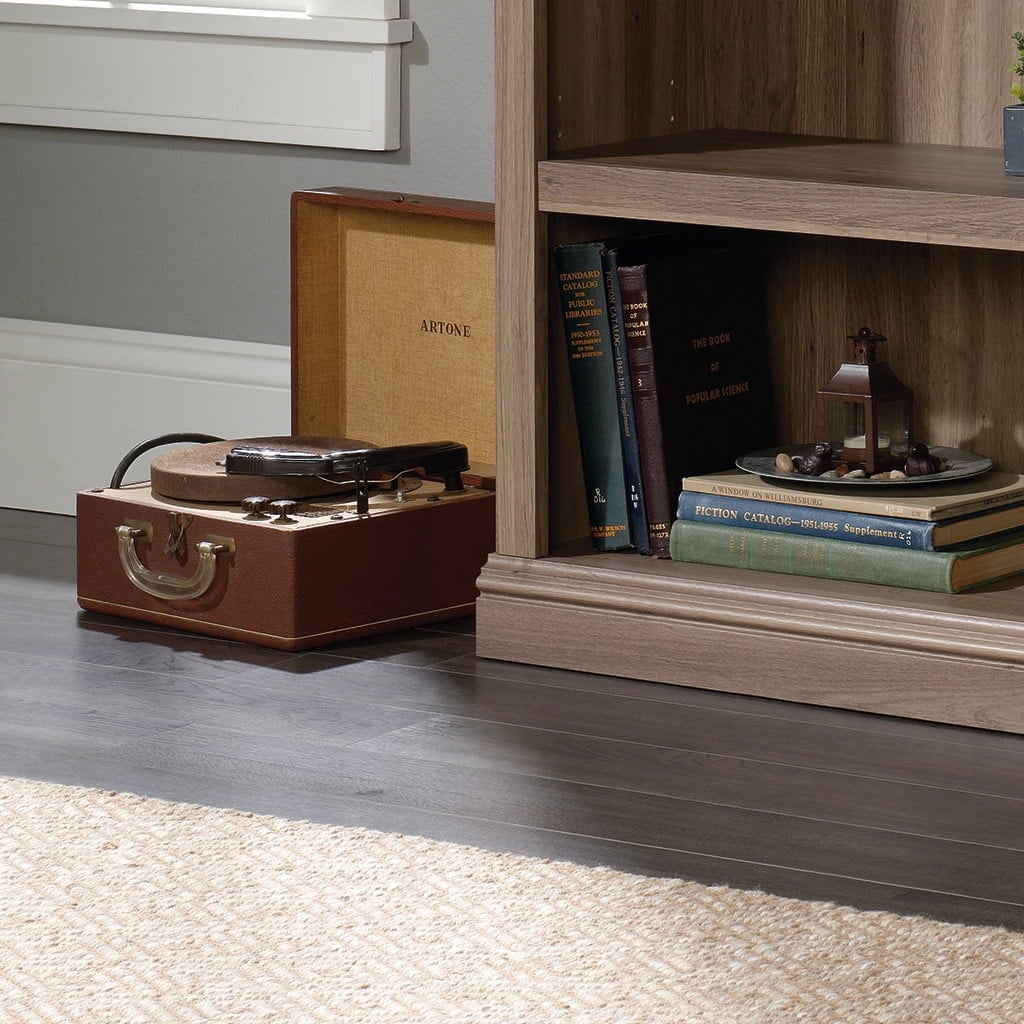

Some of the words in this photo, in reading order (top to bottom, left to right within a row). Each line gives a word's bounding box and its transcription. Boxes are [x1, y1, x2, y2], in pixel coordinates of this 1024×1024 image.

[559, 269, 600, 281] STANDARD
[562, 281, 598, 291] CATALOG
[568, 299, 596, 308] PUBLIC
[565, 308, 602, 318] LIBRARIES
[420, 319, 471, 338] ARTONE
[692, 337, 708, 350] THE
[709, 332, 731, 346] BOOK
[710, 362, 720, 371] OF
[685, 388, 720, 405] POPULAR
[722, 382, 750, 396] SCIENCE
[718, 486, 750, 497] WINDOW
[752, 491, 763, 499] ON
[764, 492, 823, 506] WILLIAMSBURG
[695, 505, 738, 519] FICTION
[843, 523, 898, 539] Supplement
